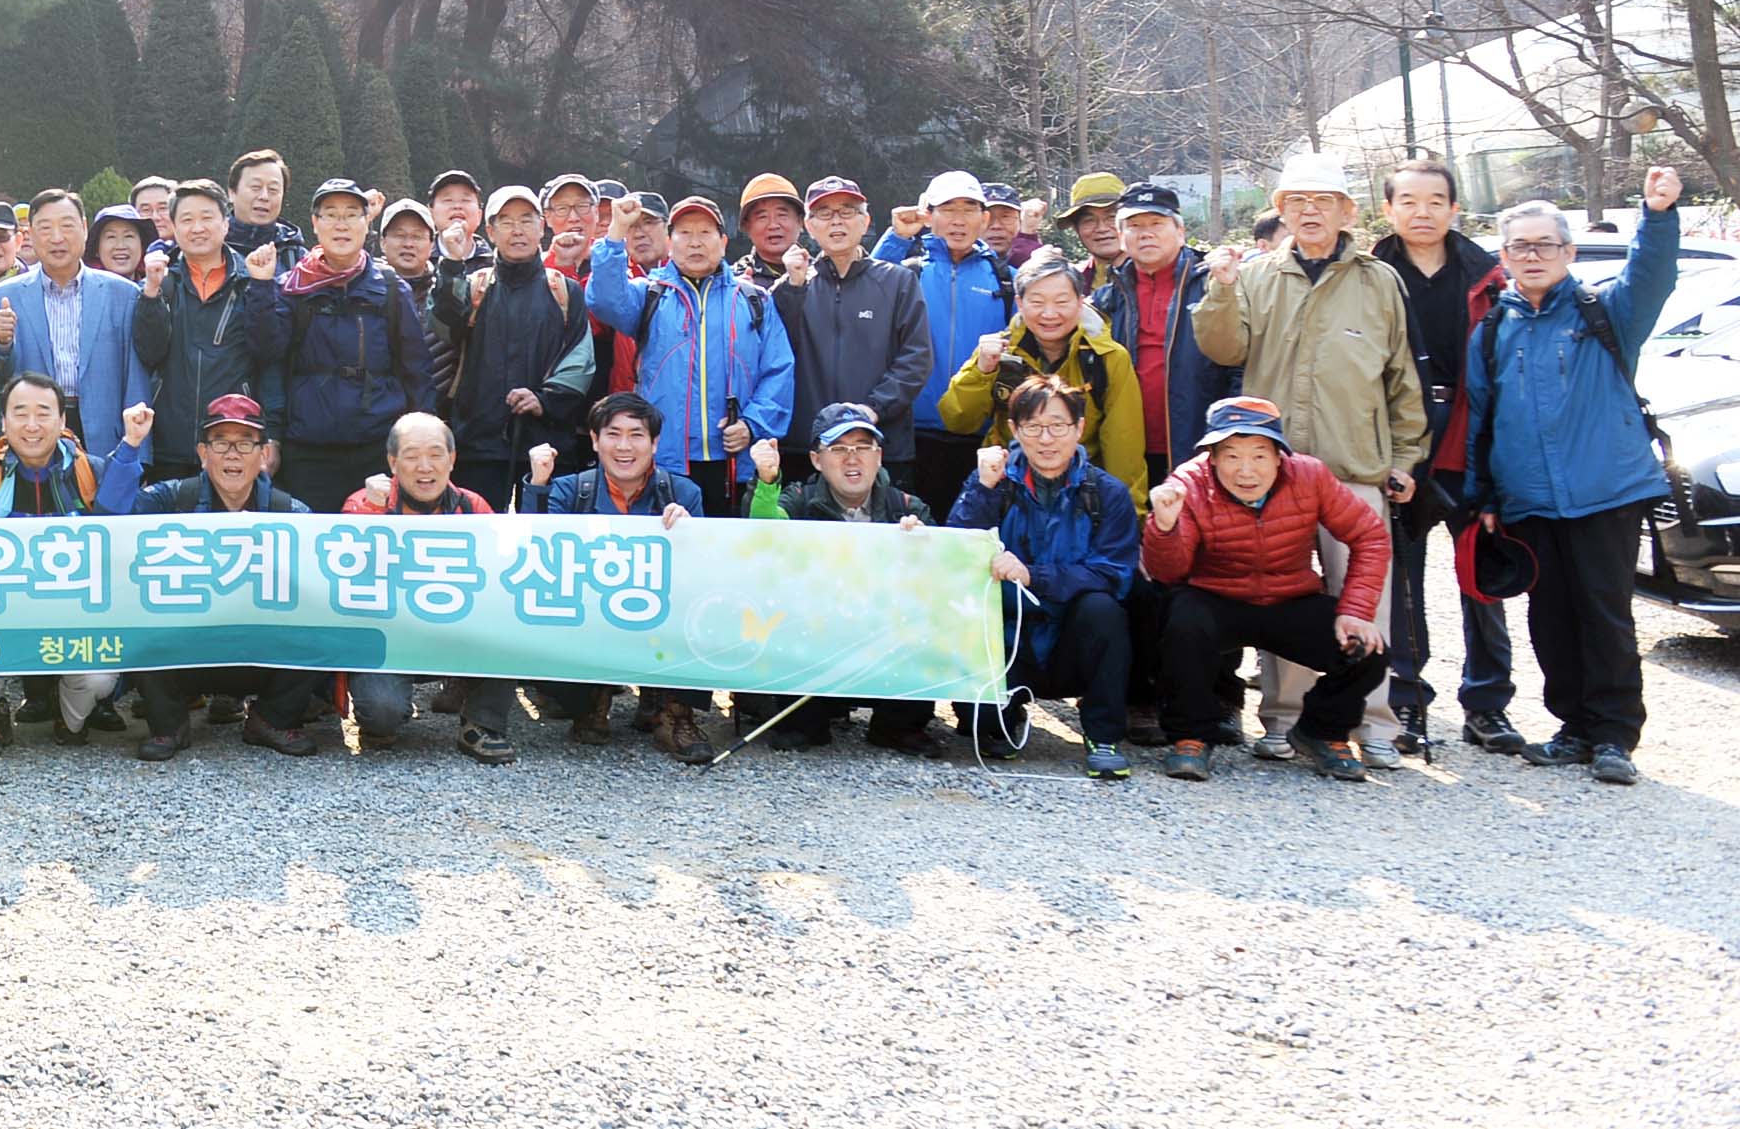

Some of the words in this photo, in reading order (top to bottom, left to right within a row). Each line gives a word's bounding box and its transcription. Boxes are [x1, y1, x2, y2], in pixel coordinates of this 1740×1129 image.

[137, 529, 291, 607] 춘계
[322, 531, 479, 614] 합동
[508, 539, 664, 622] 산행
[38, 635, 124, 665] 청계산
